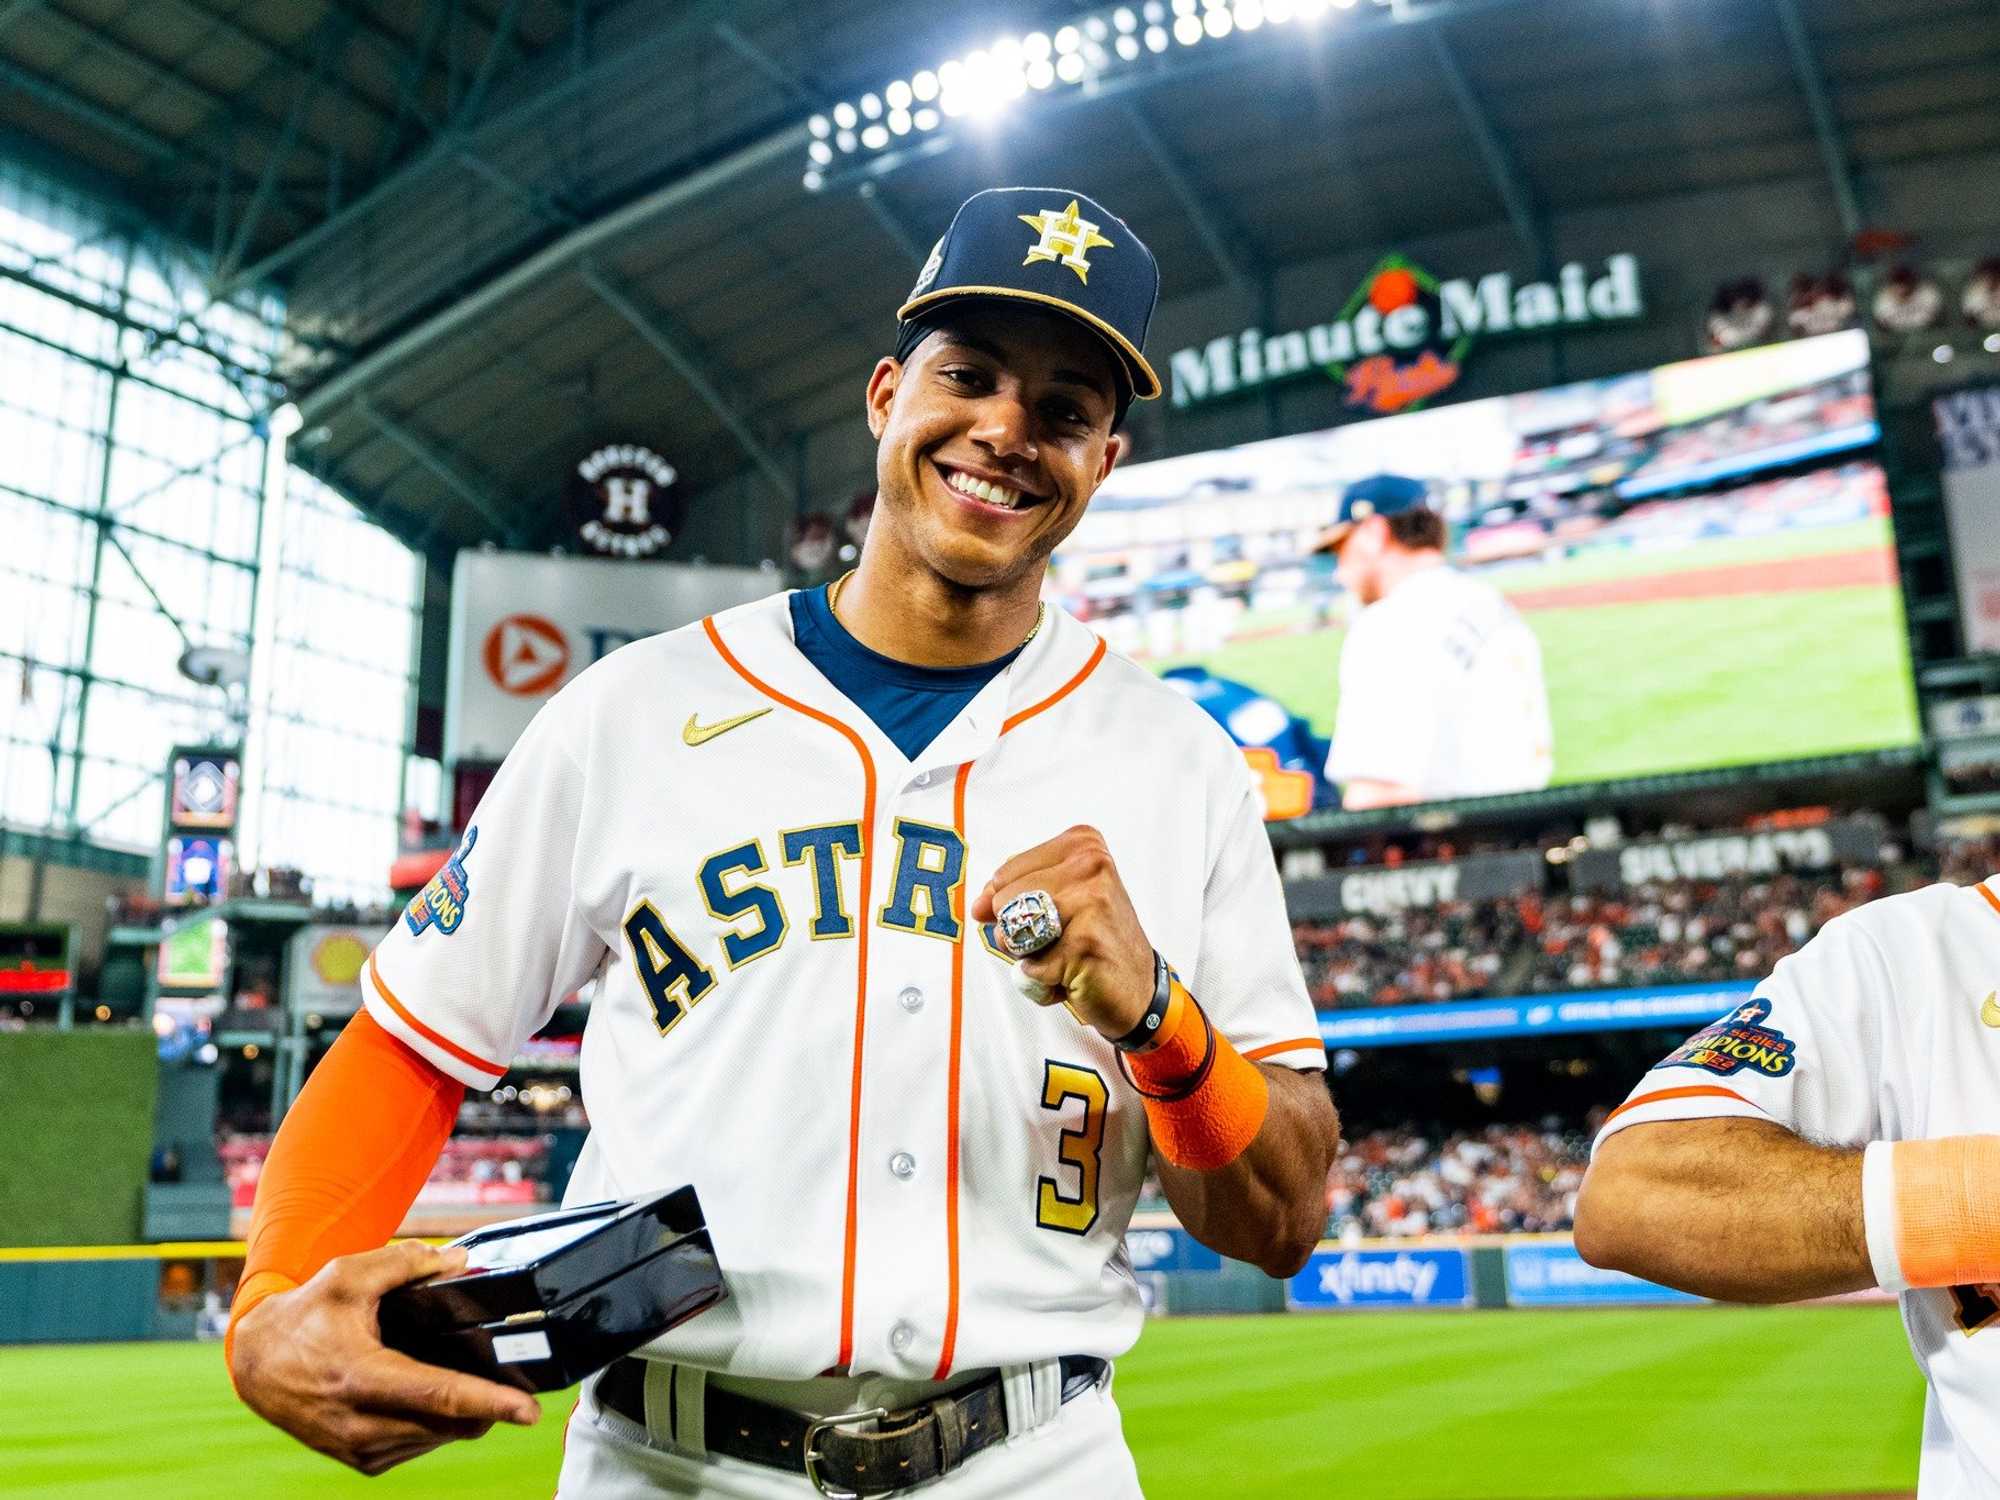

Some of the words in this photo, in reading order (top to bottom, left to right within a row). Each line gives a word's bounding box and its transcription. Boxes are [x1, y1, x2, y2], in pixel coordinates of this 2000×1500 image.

[1169, 303, 1429, 407] Minute
[1439, 253, 1642, 340] Maid
[604, 477, 651, 523] H
[622, 816, 1015, 1037] ASTR
[1036, 1060, 1109, 1237] 3
[1319, 1252, 1438, 1303] xfinity
